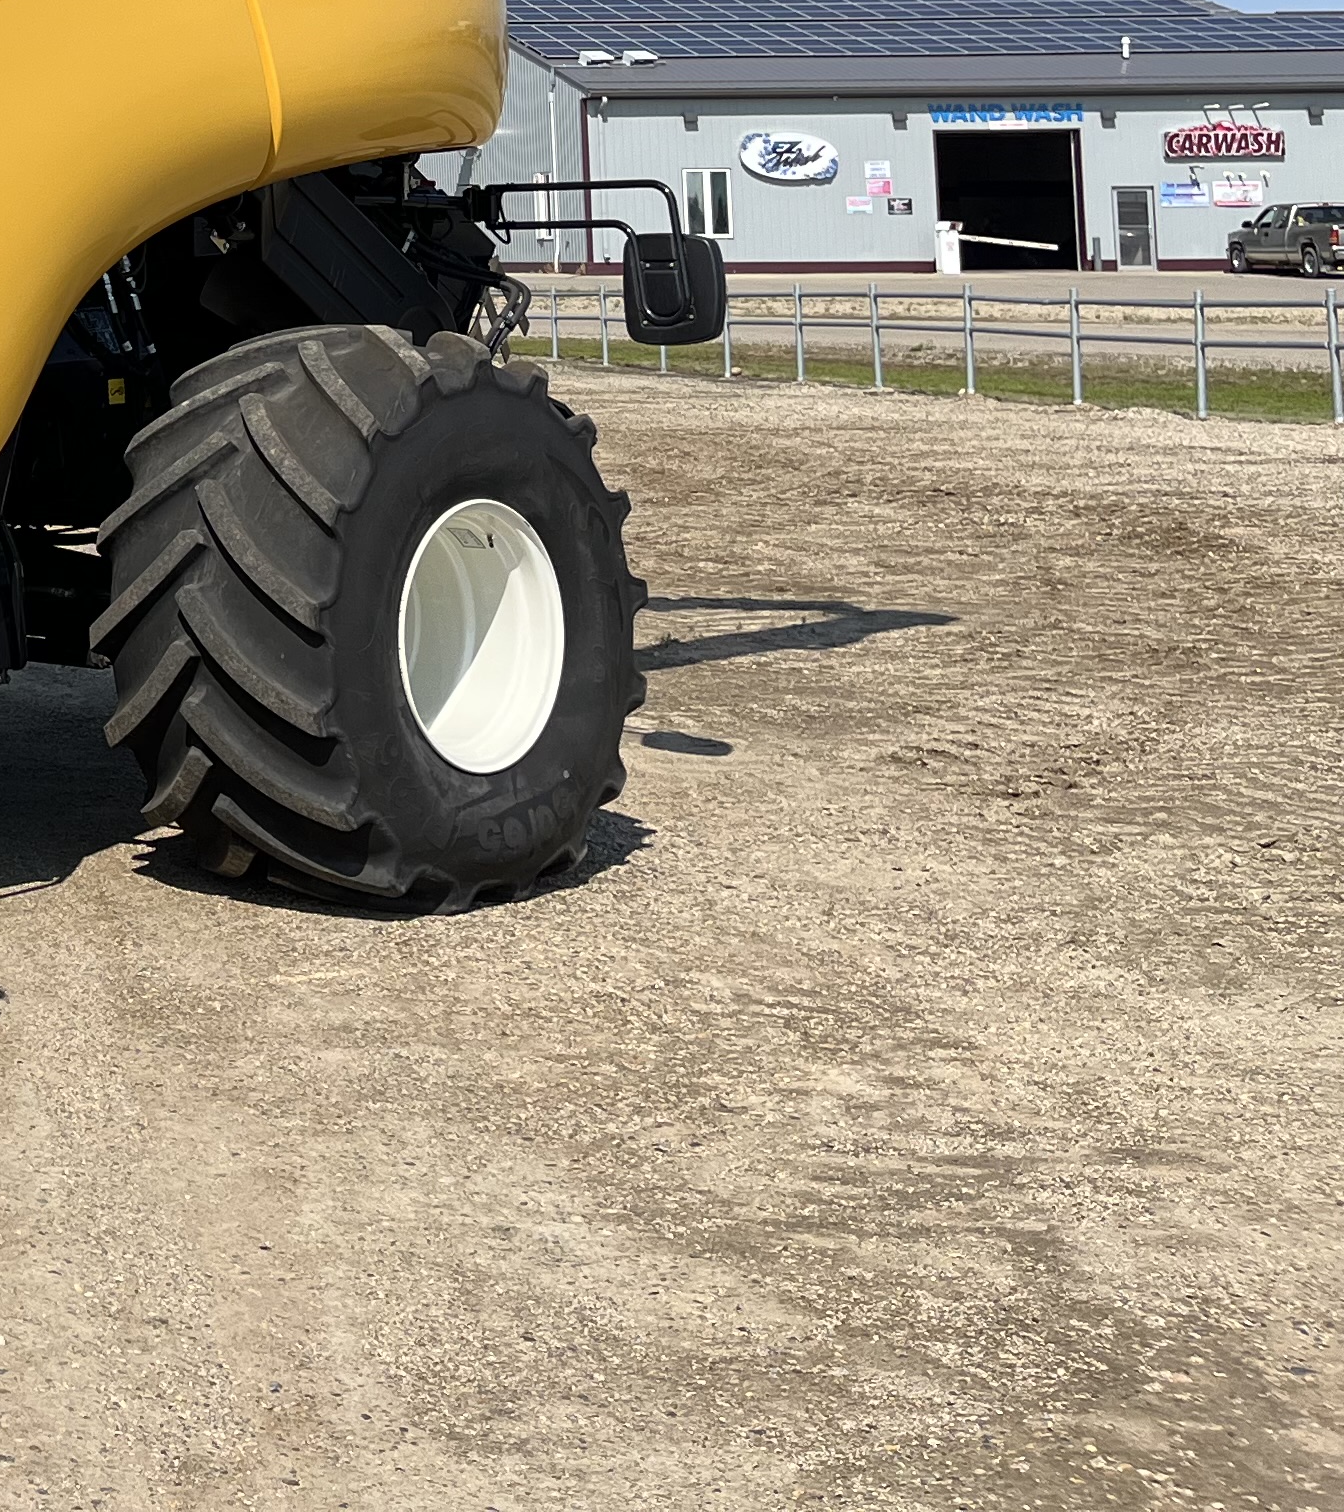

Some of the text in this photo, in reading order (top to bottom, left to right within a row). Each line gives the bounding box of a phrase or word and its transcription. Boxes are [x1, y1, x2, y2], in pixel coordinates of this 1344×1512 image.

[927, 103, 1083, 123] WAND WASH
[1166, 131, 1281, 156] CARWASH
